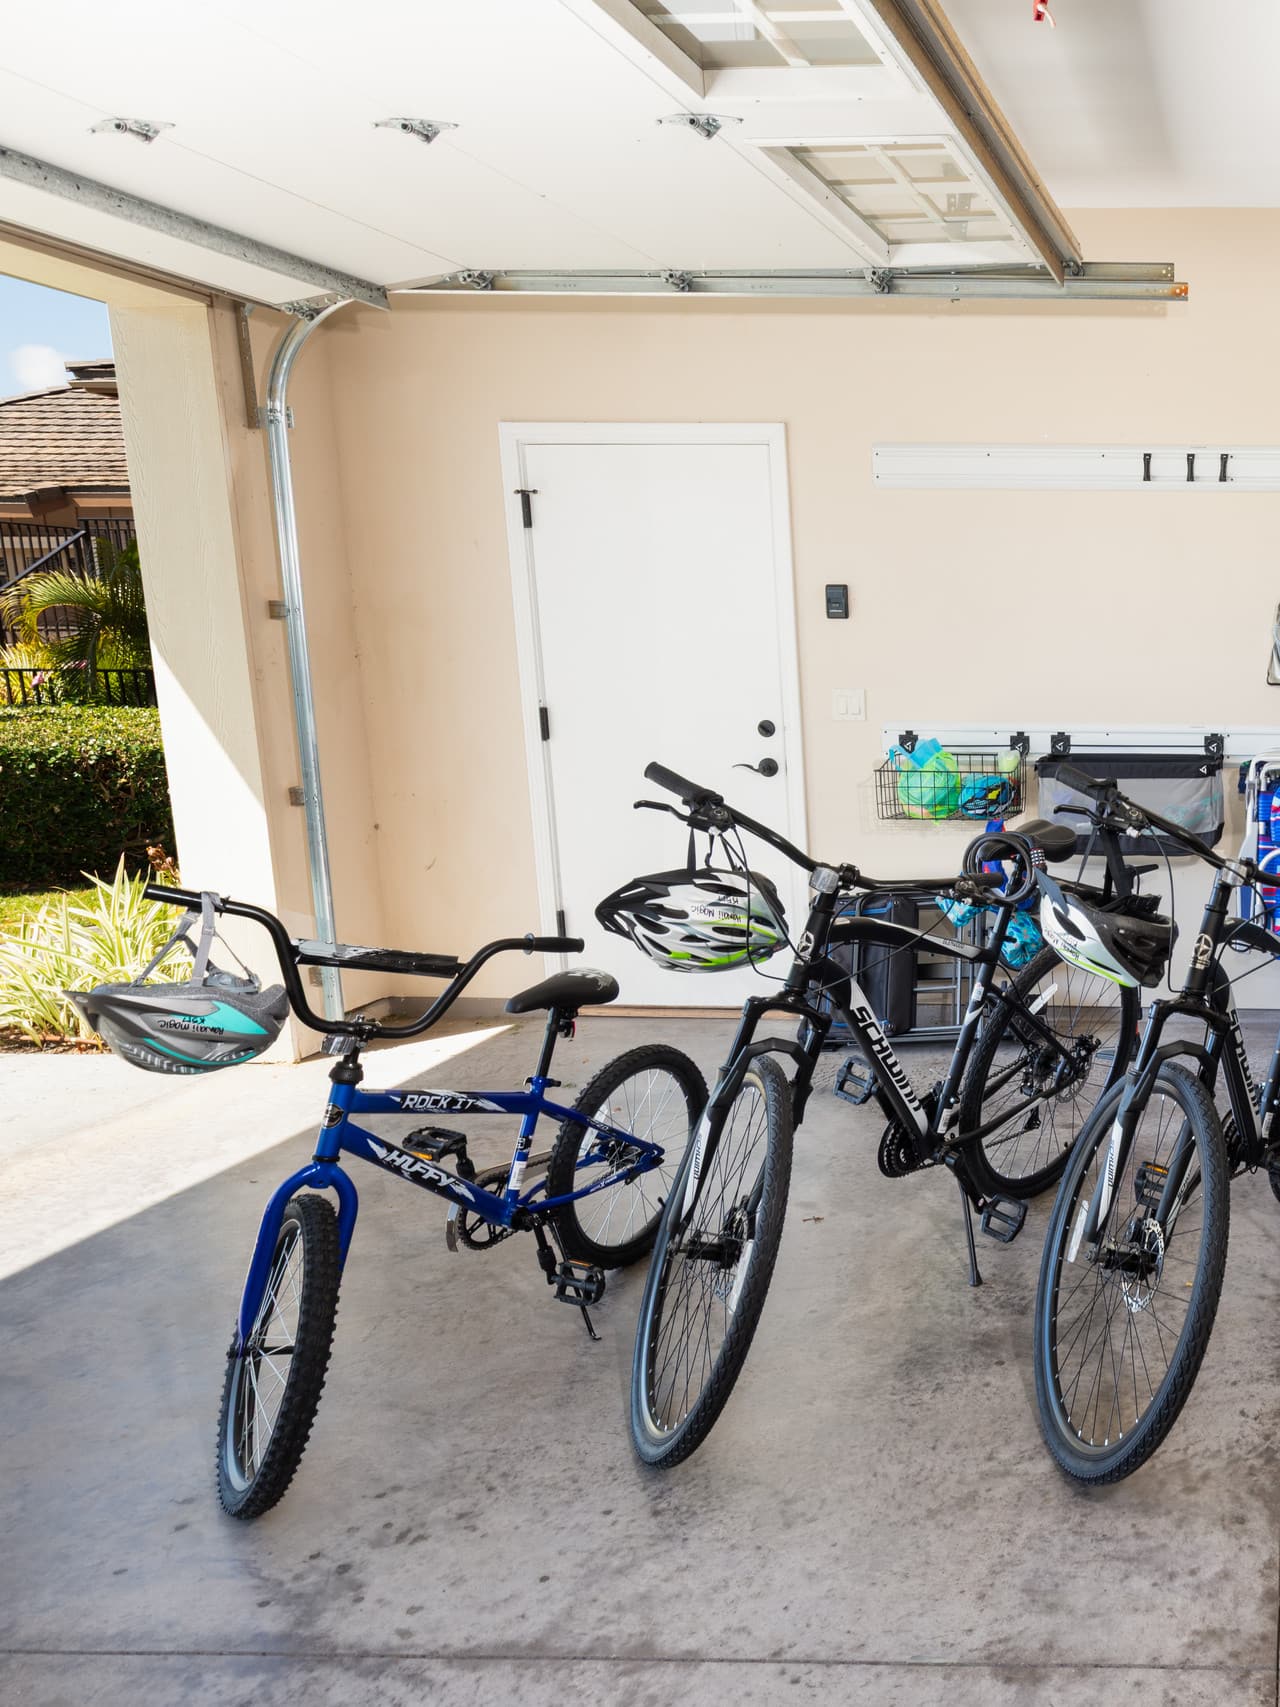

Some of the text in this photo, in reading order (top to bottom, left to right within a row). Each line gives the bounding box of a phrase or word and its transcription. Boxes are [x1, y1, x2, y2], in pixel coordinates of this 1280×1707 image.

[853, 1006, 922, 1112] SCHWINN
[402, 1094, 477, 1109] ROCK IT
[384, 1150, 456, 1187] HUFFY
